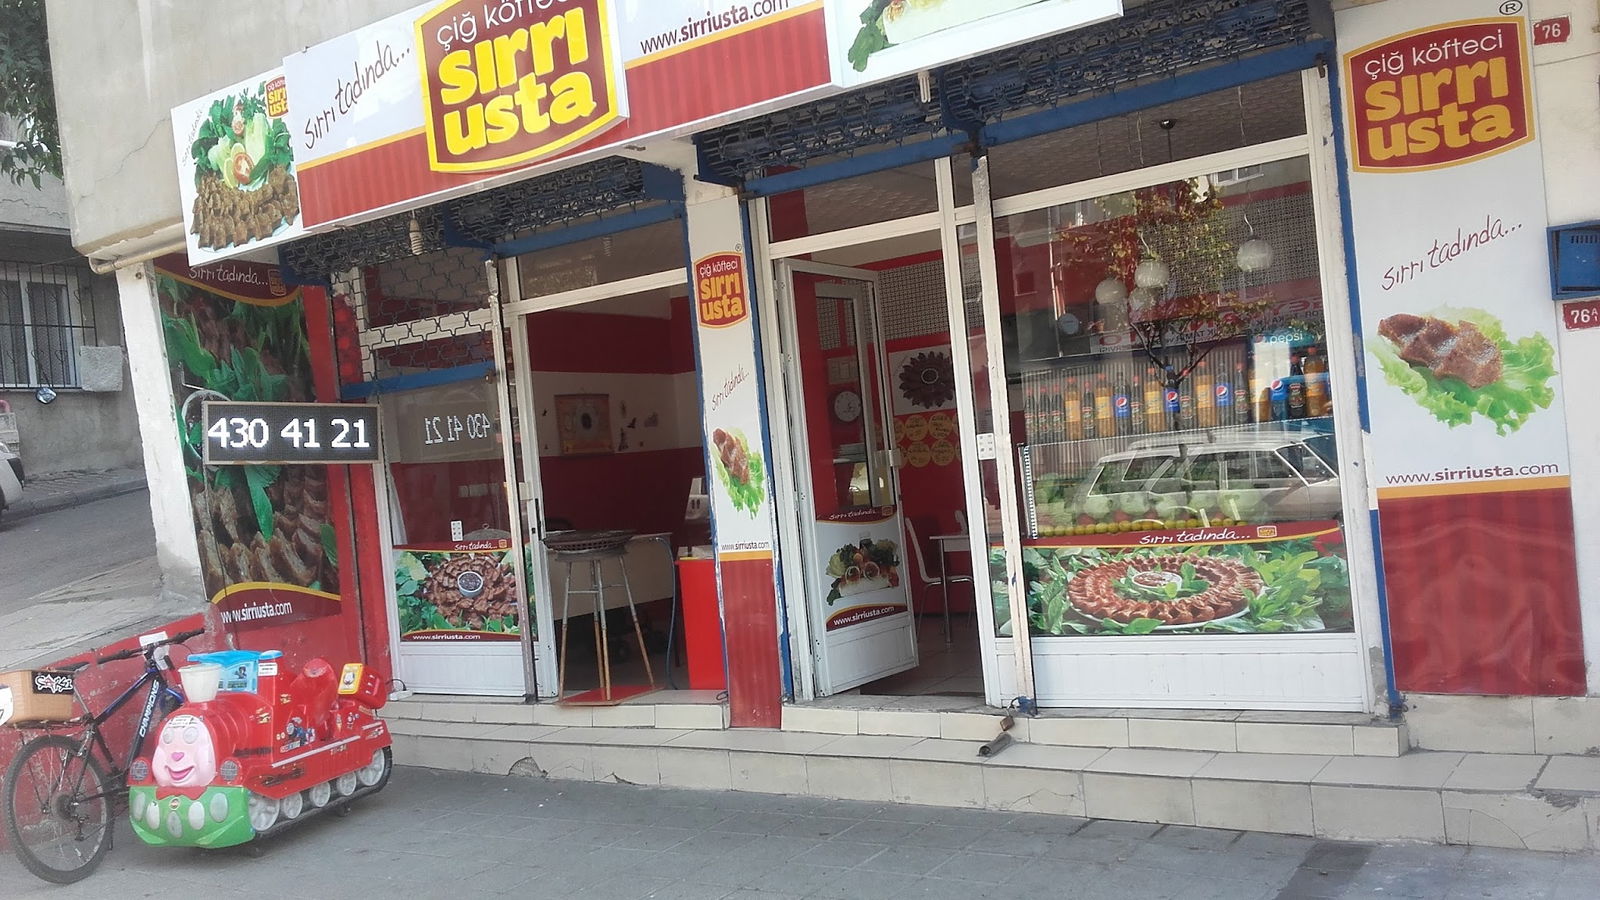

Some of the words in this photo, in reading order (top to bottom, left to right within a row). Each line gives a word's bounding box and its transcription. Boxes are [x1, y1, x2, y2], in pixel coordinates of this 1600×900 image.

[437, 12, 477, 50] çiğ
[640, 0, 789, 54] www.sirriusta.com
[1542, 23, 1562, 39] 76
[438, 7, 588, 105] sırrı
[1365, 51, 1404, 80] çiğ
[1412, 28, 1503, 66] köfteci
[1364, 56, 1509, 122] sırrı
[443, 71, 597, 155] usta
[1367, 102, 1515, 162] usta
[702, 294, 743, 320] usta
[1270, 330, 1303, 345] pepsi
[207, 417, 269, 448] 430
[280, 417, 320, 448] 41
[330, 418, 370, 448] 21
[1385, 463, 1559, 485] www.sirriusta.com
